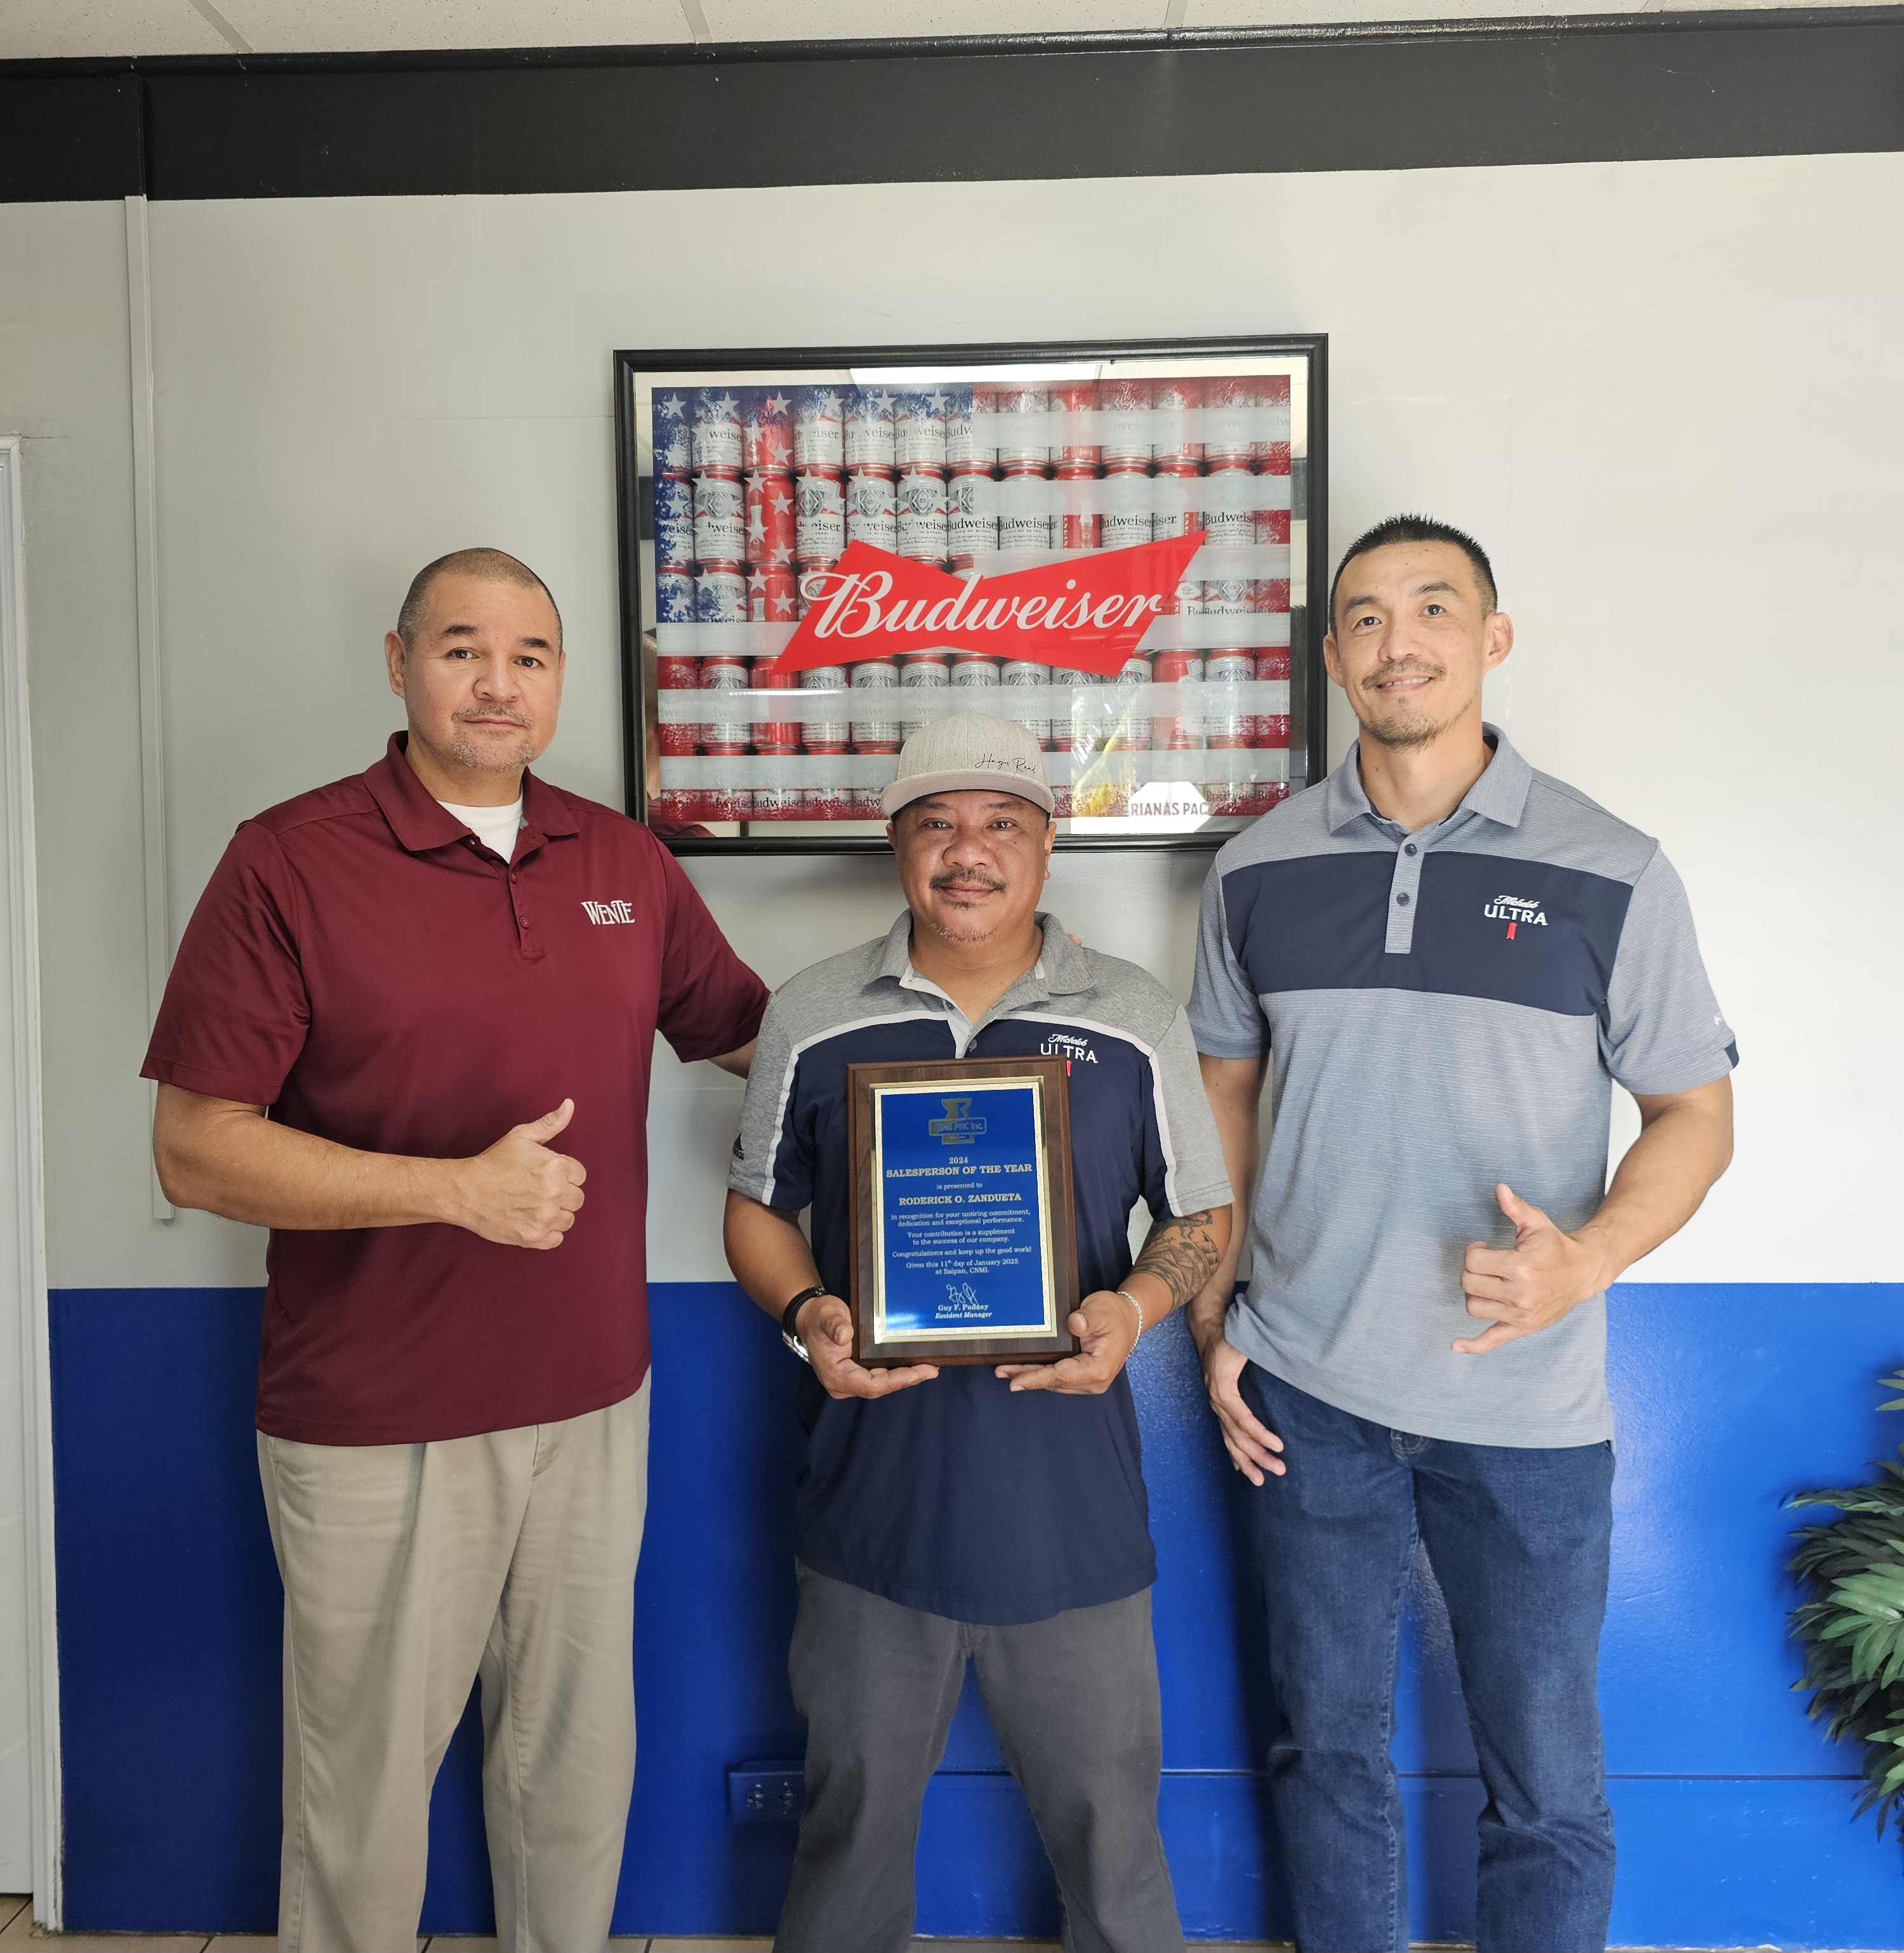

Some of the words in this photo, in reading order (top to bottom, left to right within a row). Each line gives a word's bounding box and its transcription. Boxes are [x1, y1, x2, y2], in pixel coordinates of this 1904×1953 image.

[800, 571, 1162, 638] Budweiser
[1484, 904, 1549, 925] ULTRA
[887, 1167, 960, 1177] SALESPERSON
[962, 1165, 977, 1174] OF
[979, 1165, 1001, 1173] THE
[1003, 1163, 1032, 1172] YEAR
[899, 1196, 952, 1205] RODERICK
[968, 1193, 1021, 1202] ZANDUETA
[945, 1217, 981, 1226] exceptional
[892, 1250, 943, 1259] Congratulations
[958, 1248, 973, 1256] keep
[997, 1246, 1012, 1255] good
[953, 1259, 965, 1268] day
